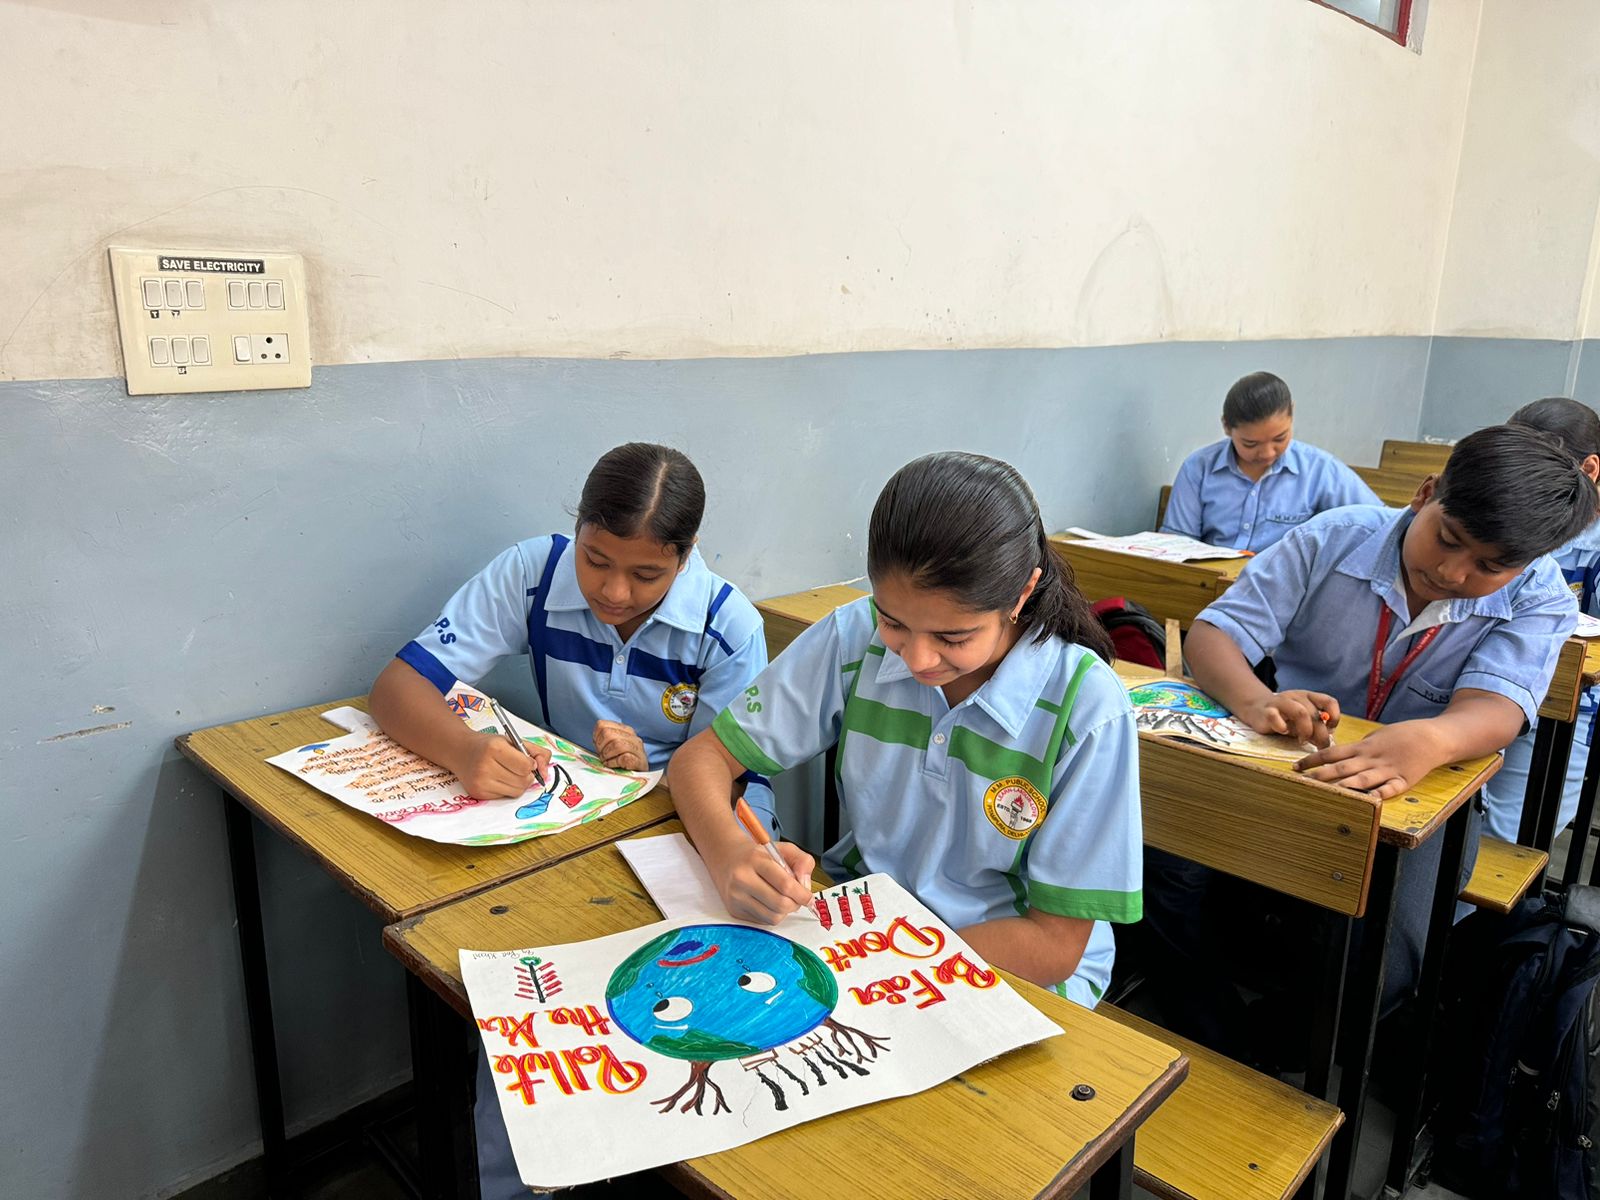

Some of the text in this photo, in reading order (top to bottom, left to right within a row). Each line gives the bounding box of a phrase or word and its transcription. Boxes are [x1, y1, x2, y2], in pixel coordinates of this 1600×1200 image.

[162, 259, 261, 273] SAVE ELECTRICITY
[820, 916, 945, 973] Don't
[848, 969, 948, 1010] Fair
[475, 1005, 613, 1049] the Air
[490, 1044, 648, 1106] Pollute
